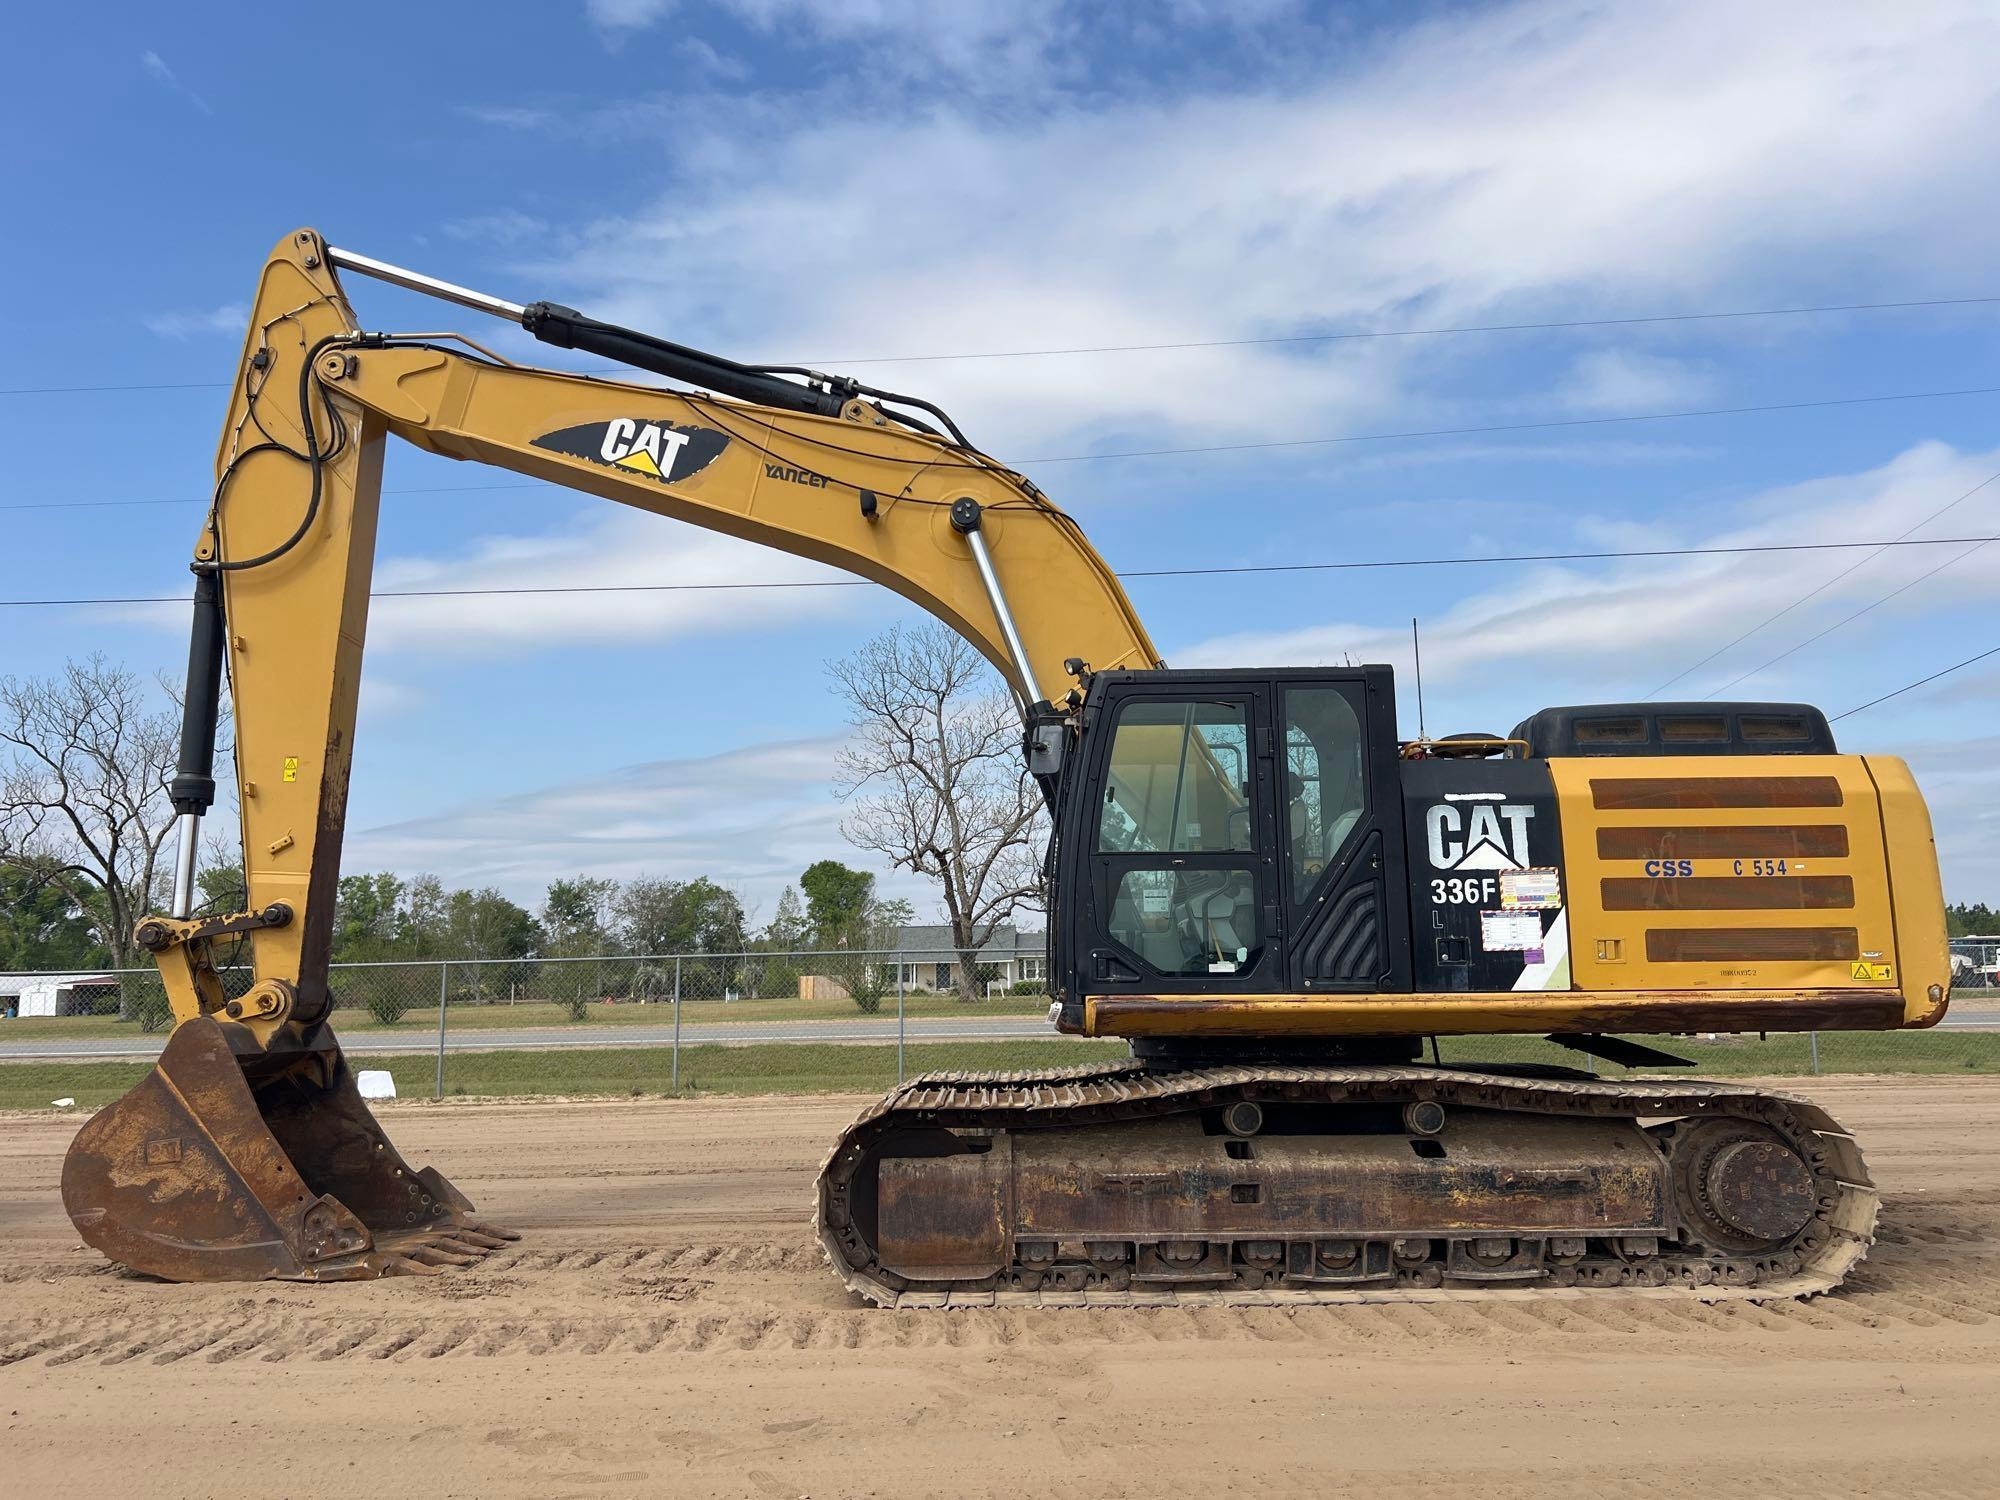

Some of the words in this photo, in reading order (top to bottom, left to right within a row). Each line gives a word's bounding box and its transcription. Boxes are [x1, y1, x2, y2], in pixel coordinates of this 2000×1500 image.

[600, 418, 690, 479] CAT
[765, 463, 828, 489] YANCEY
[1426, 804, 1535, 869] CAT
[1645, 860, 1693, 877] CSS
[1733, 859, 1743, 876] C
[1753, 859, 1787, 876] 554
[1430, 878, 1496, 904] 336F
